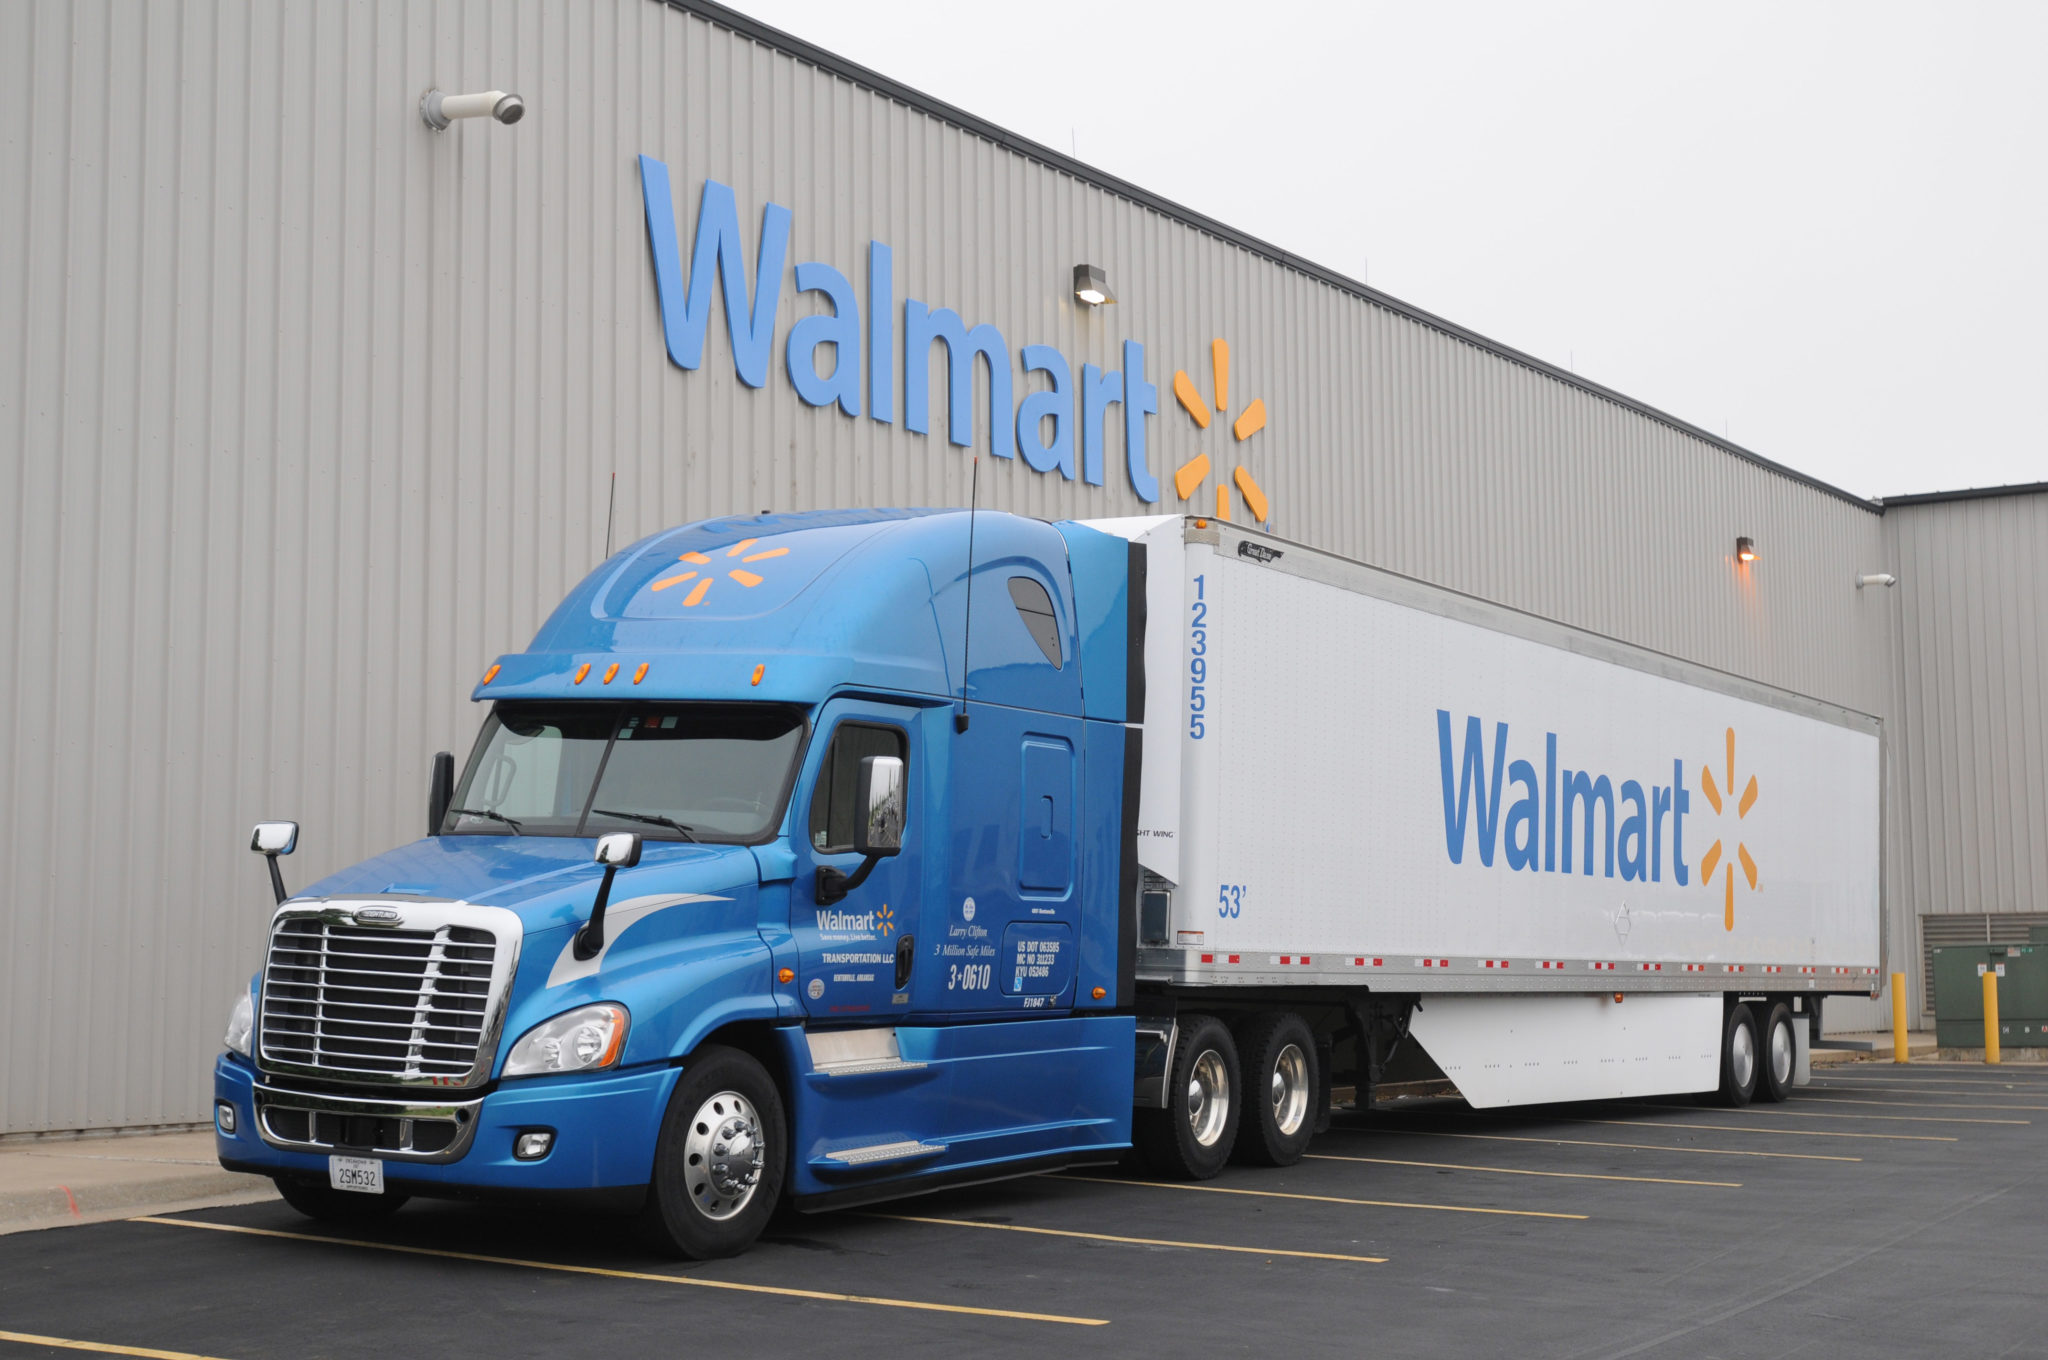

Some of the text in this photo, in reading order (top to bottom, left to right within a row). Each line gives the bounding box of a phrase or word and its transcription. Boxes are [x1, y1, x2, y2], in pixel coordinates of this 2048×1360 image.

[638, 153, 1159, 503] Walmart
[1190, 574, 1208, 740] 123955
[1436, 708, 1690, 887] Walmart
[1153, 830, 1174, 838] WING
[816, 910, 875, 931] Walmart
[949, 924, 967, 940] Larry
[933, 943, 941, 956] 3
[942, 944, 966, 957] Million
[1017, 941, 1026, 952] US
[1027, 941, 1039, 953] DOT
[822, 953, 895, 964] TRANSPORTATION LLC
[1016, 953, 1026, 965] MC
[1015, 966, 1028, 977] KYU
